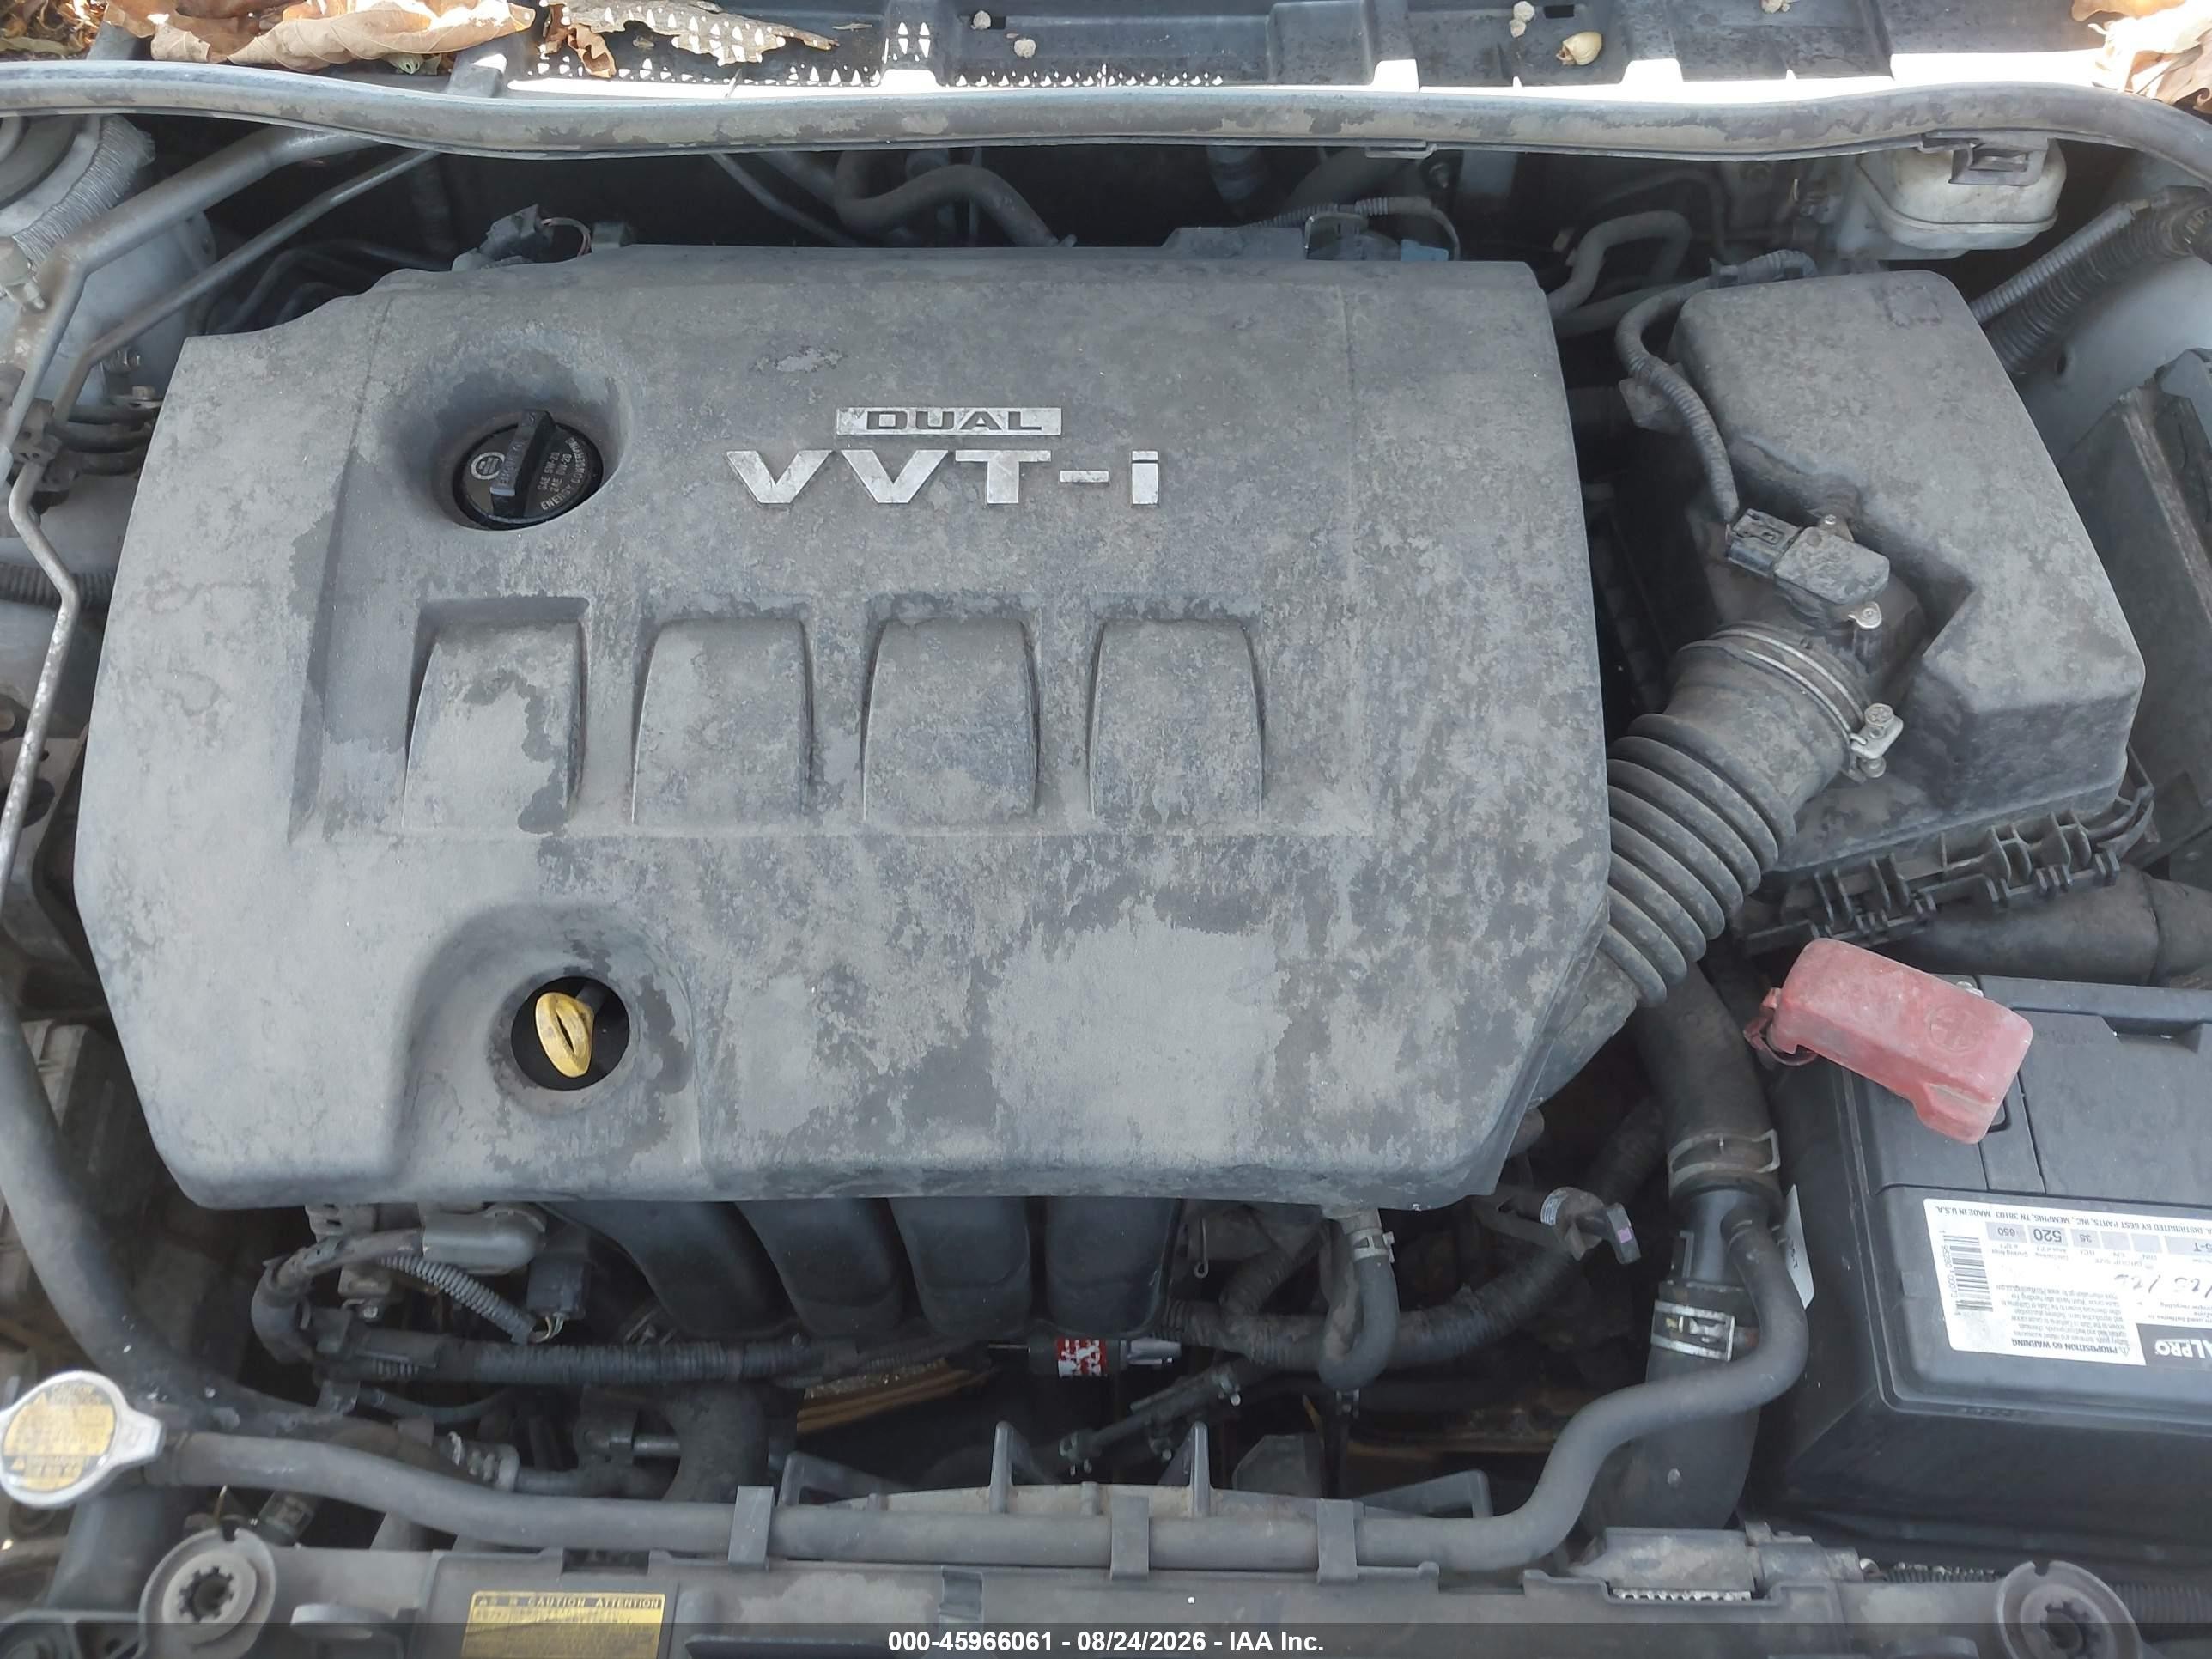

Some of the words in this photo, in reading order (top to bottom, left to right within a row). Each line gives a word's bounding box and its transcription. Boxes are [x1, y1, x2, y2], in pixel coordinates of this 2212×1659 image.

[866, 410, 1042, 430] DUAL
[540, 484, 571, 511] ENERGY
[564, 437, 586, 484] CONSERVING
[726, 449, 1159, 505] VVT-i
[1936, 1205, 1957, 1214] U.S.A.
[1960, 1207, 1966, 1216] IN
[1968, 1208, 1990, 1218] MADE
[2121, 1220, 2139, 1229] BEST
[1998, 1227, 2015, 1237] 650
[2033, 1227, 2062, 1243] 520
[2011, 1338, 2051, 1348] WARNING
[2065, 1342, 2118, 1354] PROPOSITION
[528, 1596, 586, 1607] CAUTION
[596, 1597, 659, 1608] ATTENTION
